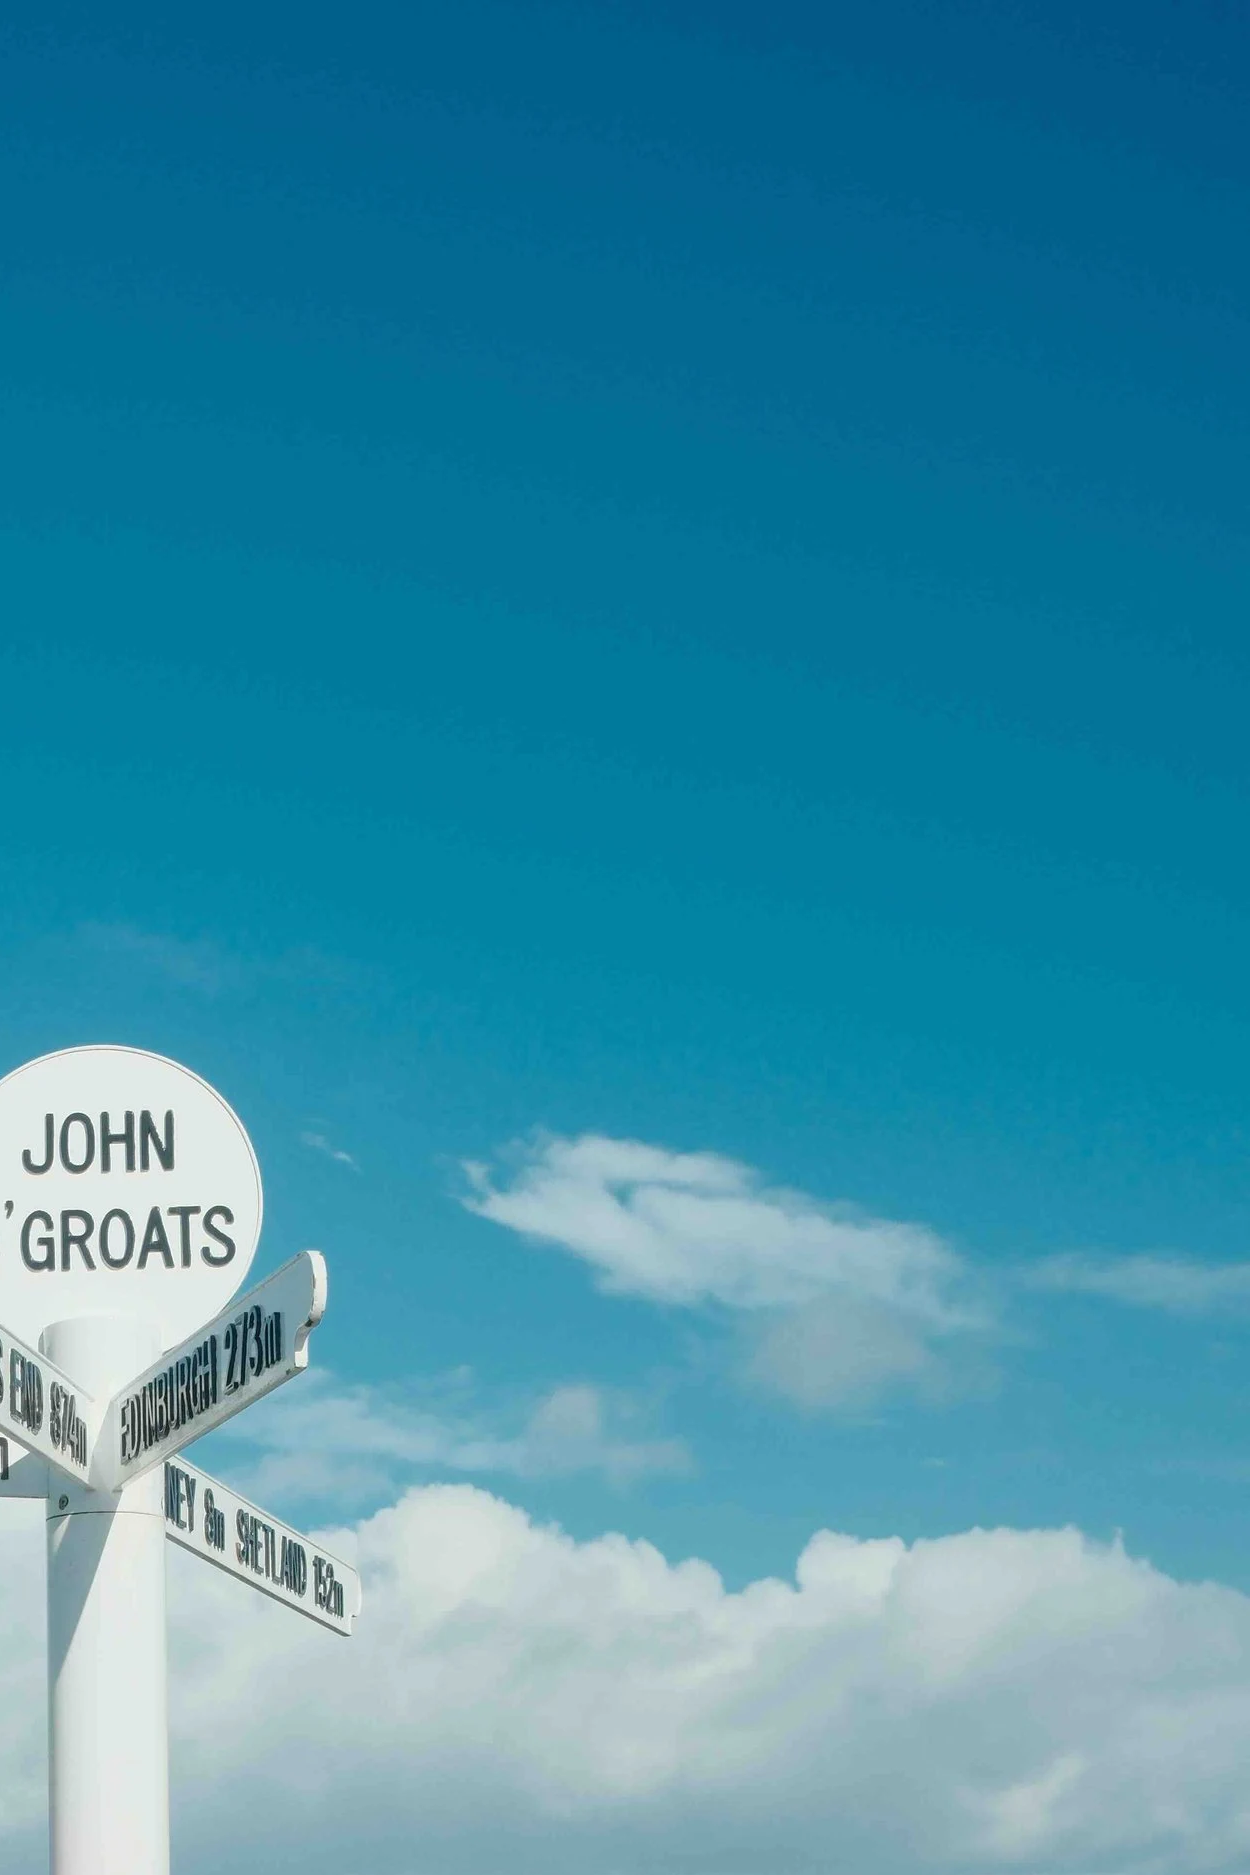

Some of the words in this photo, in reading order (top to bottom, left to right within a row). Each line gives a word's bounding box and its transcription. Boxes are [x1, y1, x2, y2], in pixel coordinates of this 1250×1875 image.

[22, 1109, 175, 1175] JOHN
[10, 1348, 43, 1436] END
[121, 1335, 218, 1465] EDINBURGH
[224, 1305, 282, 1396] 273m
[163, 1461, 197, 1533] NEY
[204, 1487, 226, 1552] 8m
[235, 1508, 308, 1599] SHETLAND
[312, 1555, 344, 1619] 152m
